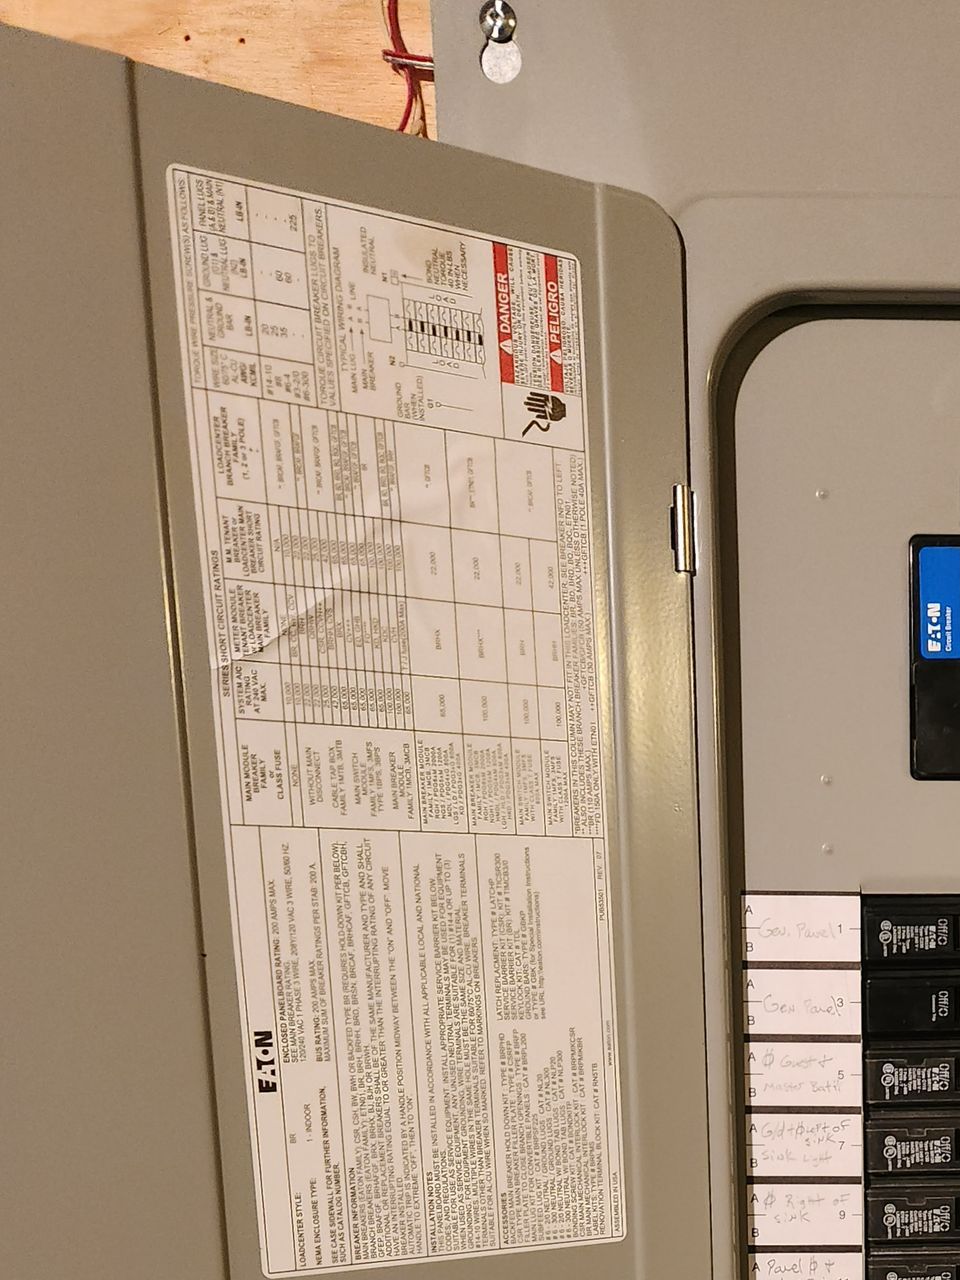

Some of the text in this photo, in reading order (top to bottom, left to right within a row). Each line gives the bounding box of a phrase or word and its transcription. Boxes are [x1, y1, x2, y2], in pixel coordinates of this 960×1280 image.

[497, 272, 511, 333] DANGER
[546, 281, 562, 344] PELIGRO
[927, 603, 941, 652] EATON
[838, 923, 842, 934] 1
[276, 969, 287, 1020] PANELBOARD
[836, 997, 844, 1008] 3
[255, 1030, 277, 1093] EATON
[280, 1023, 291, 1063] ENCLOSED
[838, 1069, 846, 1080] 5
[838, 1140, 846, 1150] 7
[348, 1167, 362, 1260] BREAKER INFORMATION
[839, 1210, 846, 1220] 9
[297, 1219, 307, 1267] LOADCENTER
